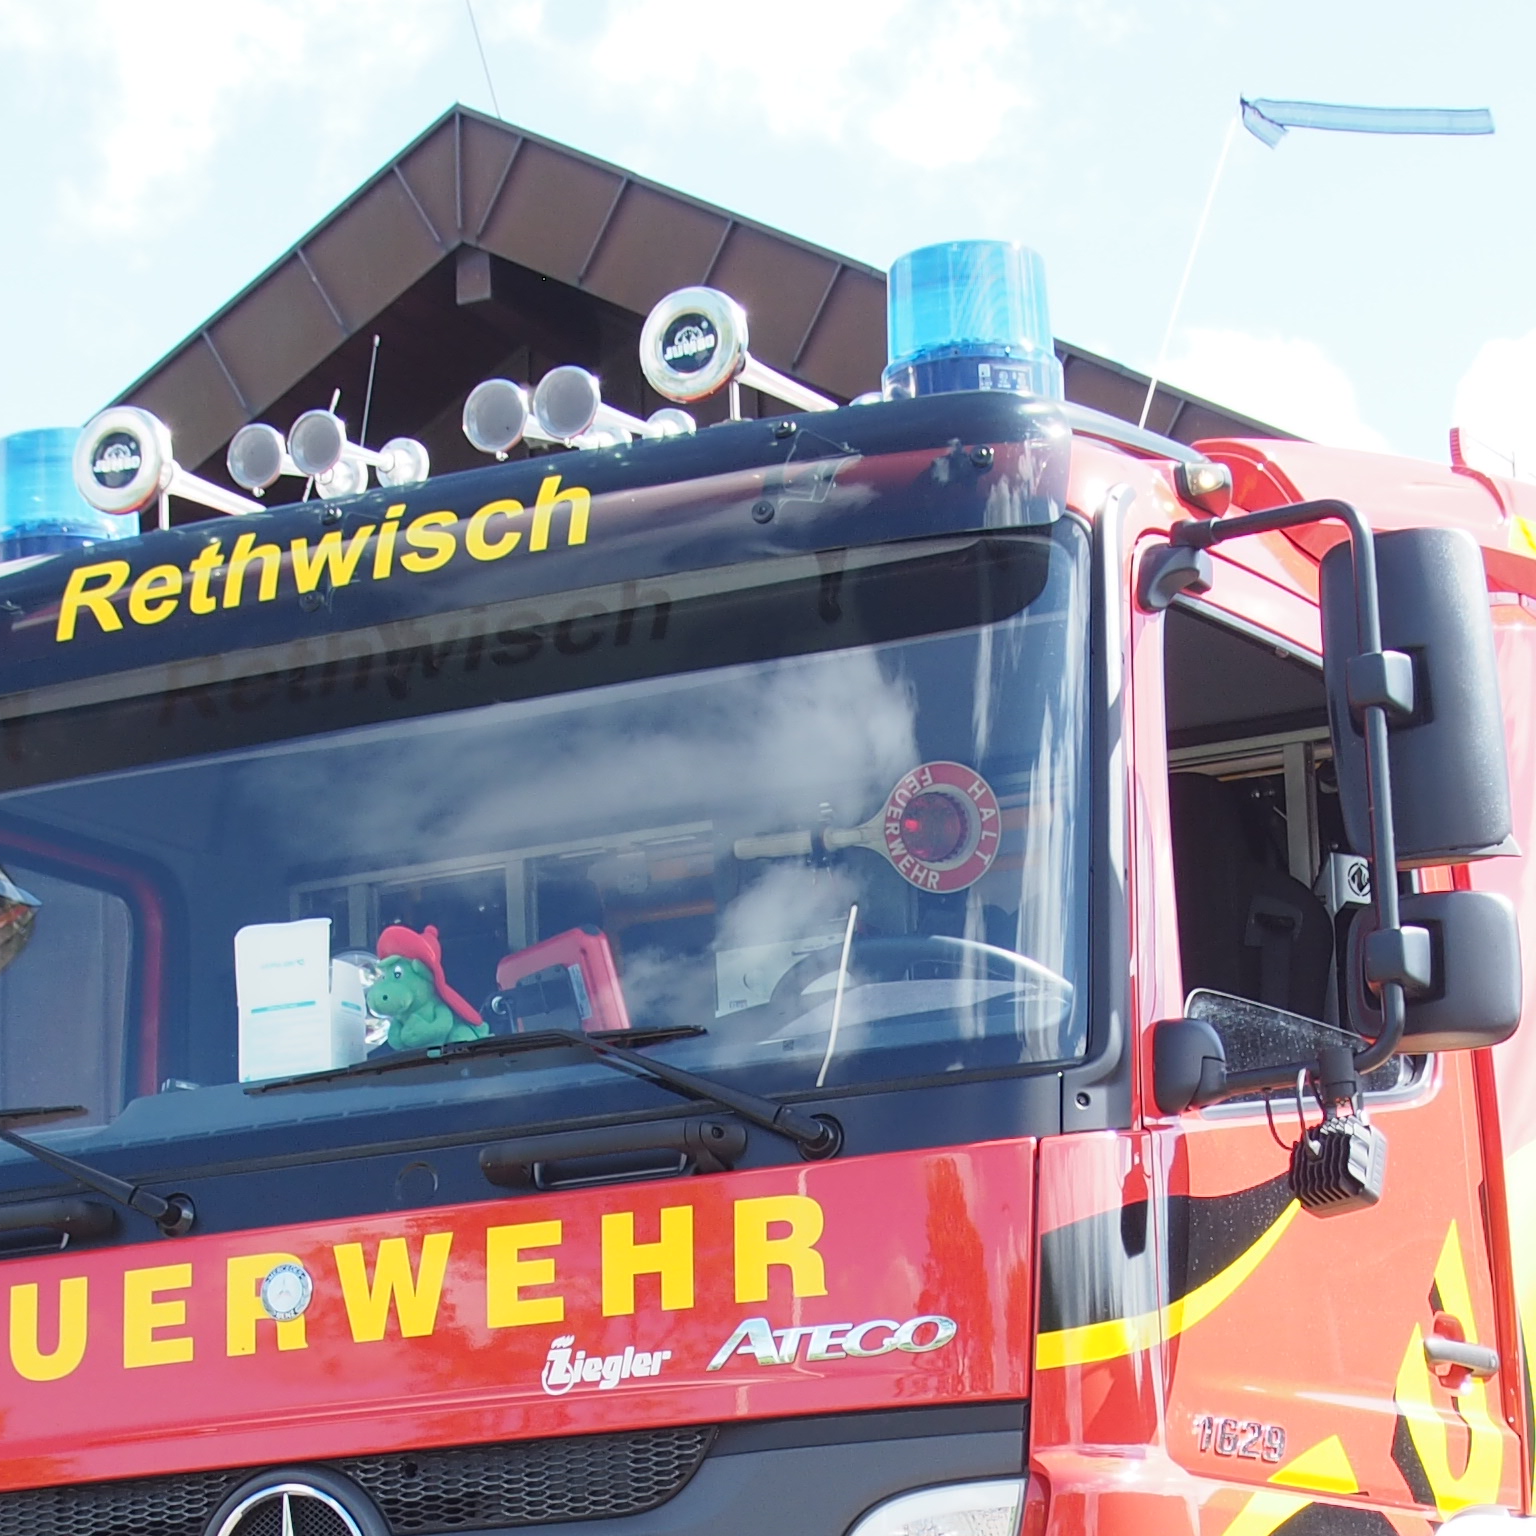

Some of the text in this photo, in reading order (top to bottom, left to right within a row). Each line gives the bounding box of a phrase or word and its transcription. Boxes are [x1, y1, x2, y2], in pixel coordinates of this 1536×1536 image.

[56, 474, 592, 642] Rethwisch
[885, 767, 940, 890] FEUERWEHR
[967, 780, 998, 866] HALT
[541, 1336, 672, 1396] Ziegler
[1195, 1416, 1286, 1464] 1629
